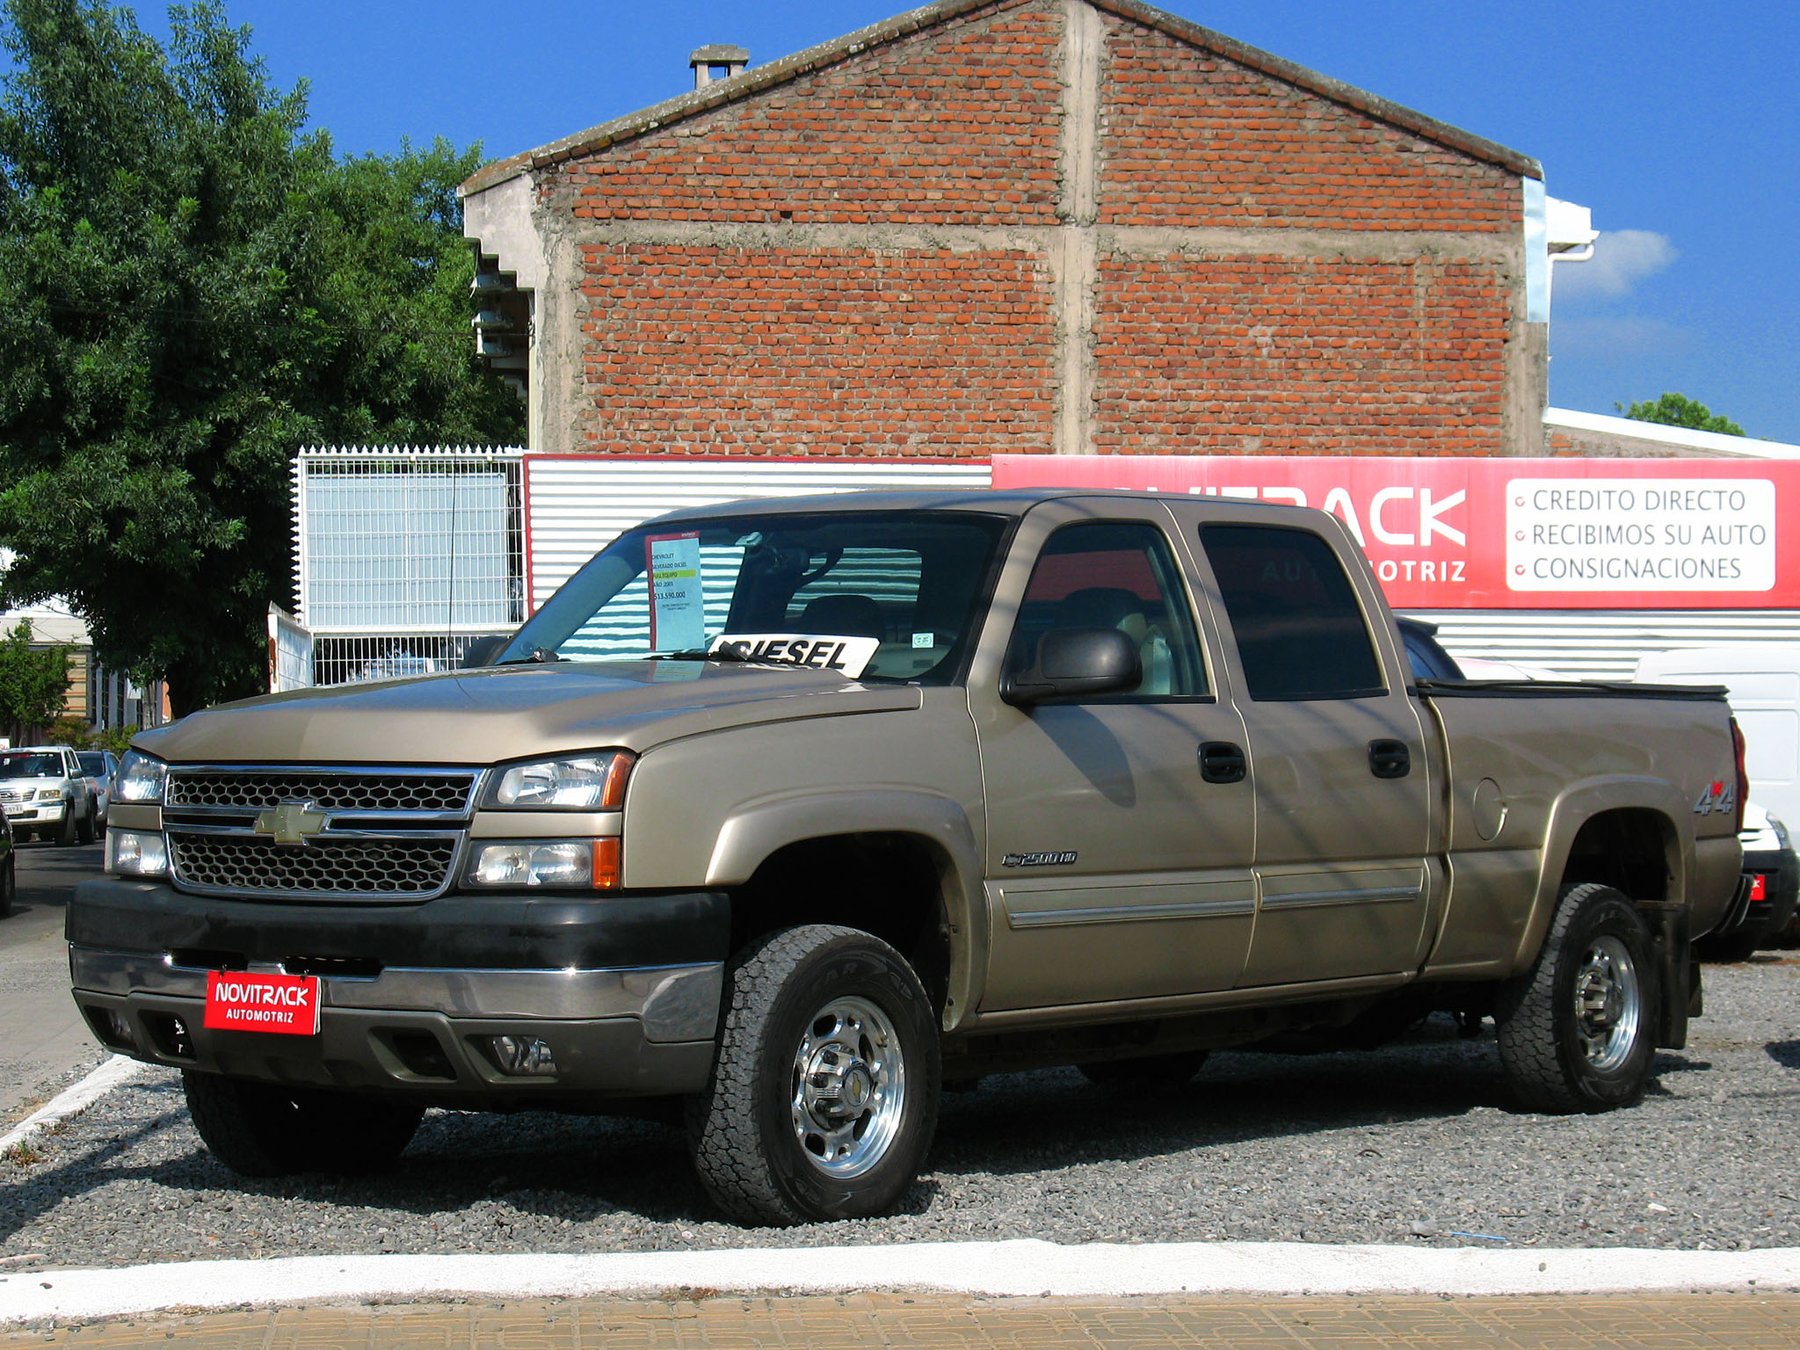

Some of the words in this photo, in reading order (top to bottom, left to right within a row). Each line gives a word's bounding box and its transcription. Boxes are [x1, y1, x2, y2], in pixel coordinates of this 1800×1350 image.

[1533, 489, 1635, 511] CREDITO
[1645, 489, 1746, 511] DIRECTO
[1533, 524, 1656, 545] RECIBIMOS
[1664, 524, 1692, 545] SU
[1701, 524, 1766, 545] AUTO
[1533, 557, 1742, 579] CONSIGNACIONES
[215, 982, 309, 1007] NOVITRACK
[226, 1008, 294, 1023] AUTOMOTRIZ
